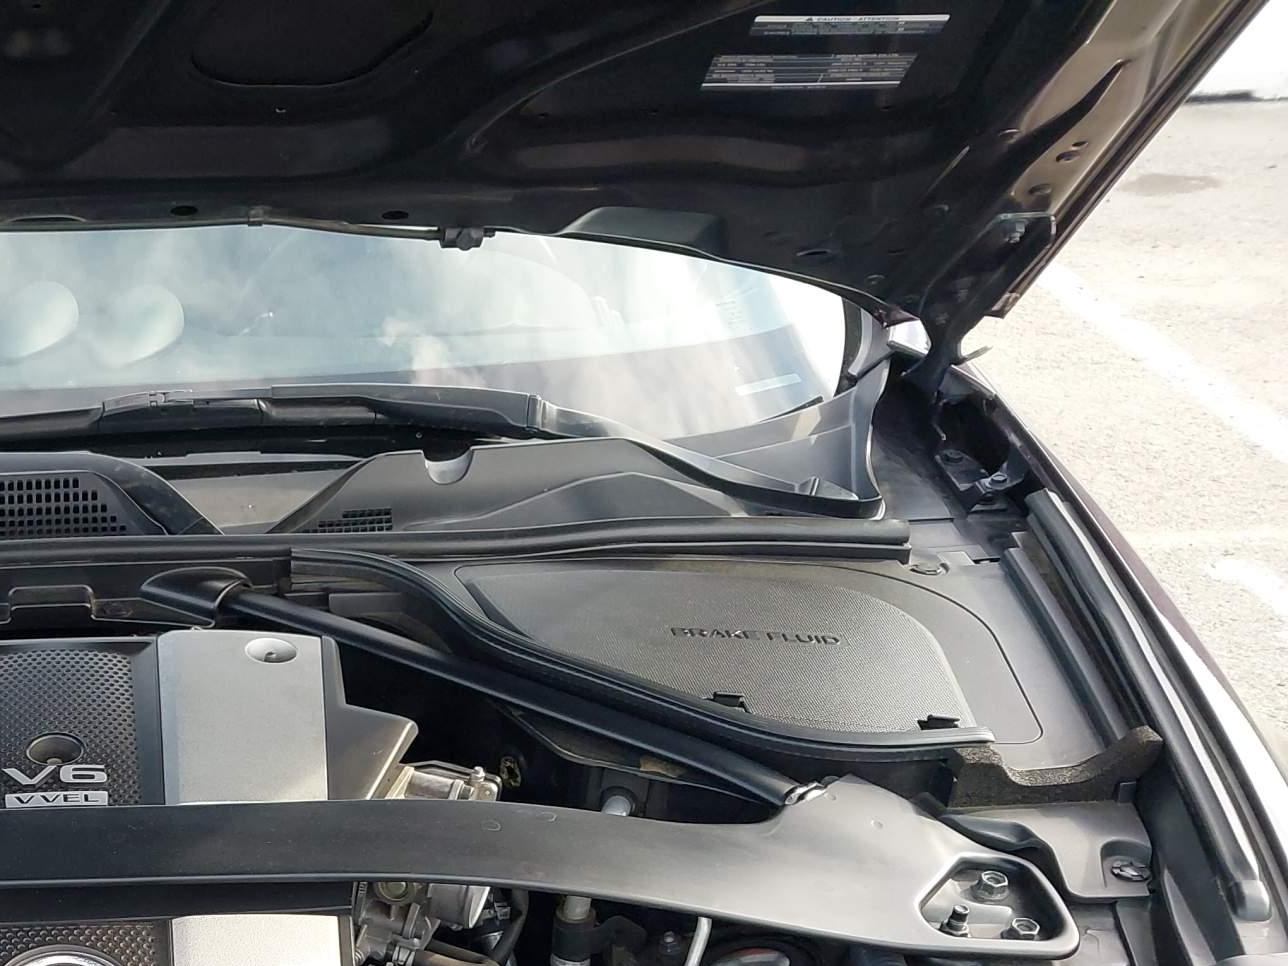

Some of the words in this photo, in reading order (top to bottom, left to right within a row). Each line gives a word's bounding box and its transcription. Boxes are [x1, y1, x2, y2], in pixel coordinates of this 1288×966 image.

[670, 627, 761, 641] BRAKE
[767, 632, 840, 645] FLUID
[2, 764, 108, 785] V6
[13, 793, 101, 805] VVEL
